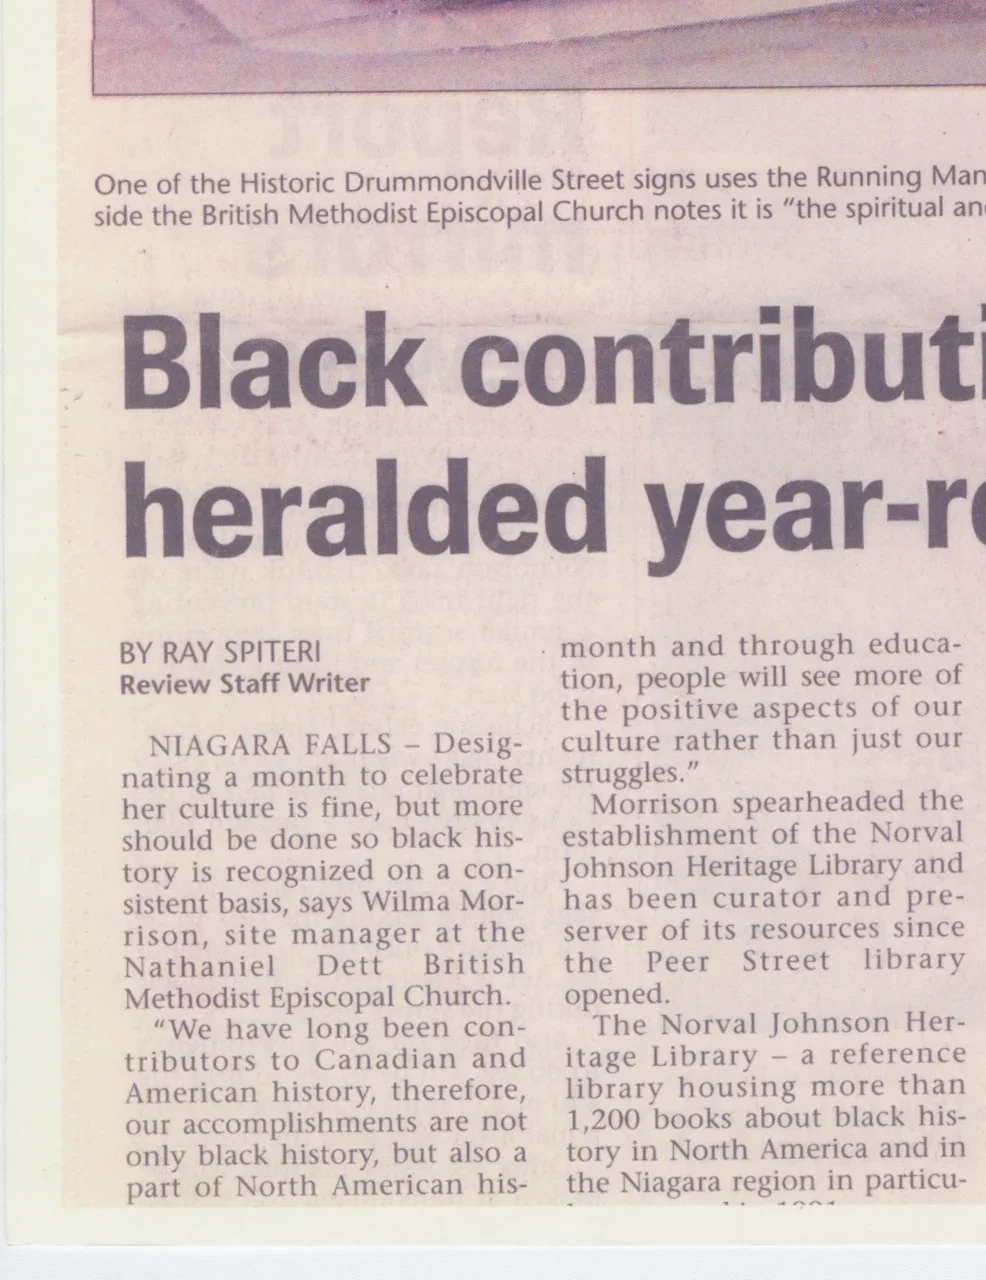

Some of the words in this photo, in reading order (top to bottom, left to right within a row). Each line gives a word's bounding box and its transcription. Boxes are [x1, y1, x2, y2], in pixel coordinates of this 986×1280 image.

[95, 174, 147, 195] One
[157, 172, 181, 195] of
[190, 172, 230, 194] the
[241, 172, 335, 194] Historic
[345, 169, 542, 192] Drummondville
[552, 168, 625, 190] Street
[634, 168, 696, 196] signs
[706, 172, 757, 189] uses
[767, 166, 807, 188] the
[818, 165, 922, 193] Running
[932, 164, 986, 186] Man
[95, 205, 143, 226] side
[152, 204, 192, 226] the
[203, 203, 278, 225] British
[289, 202, 418, 225] Methodist
[427, 200, 543, 230] Episcopal
[553, 199, 644, 222] Church
[655, 201, 722, 220] notes
[732, 198, 747, 219] it
[756, 198, 773, 219] is
[846, 195, 943, 225] spiritual
[124, 311, 427, 409] Black
[125, 456, 607, 558] heralded
[120, 641, 153, 664] BY
[163, 641, 214, 664] RAY
[224, 640, 320, 664] SPITERI
[120, 674, 211, 695] Review
[220, 672, 281, 694] Staff
[287, 672, 371, 693] Writer
[561, 668, 622, 693] tion,
[637, 666, 726, 696] people
[738, 665, 787, 687] will
[801, 670, 840, 687] see
[854, 669, 922, 686] more
[936, 662, 963, 685] of
[122, 767, 211, 795] nating
[225, 771, 238, 788] a
[253, 764, 346, 787] month
[360, 767, 387, 786] to
[401, 763, 523, 786] celebrate
[591, 793, 718, 815] Morrison
[733, 789, 904, 820] spearheaded
[919, 789, 963, 811] the
[560, 856, 674, 883] Johnson
[687, 855, 797, 883] Heritage
[809, 853, 903, 881] Library
[914, 852, 964, 874] and
[123, 894, 208, 915] sistent
[218, 892, 288, 917] basis,
[300, 896, 352, 920] says
[362, 890, 450, 912] Wilma
[460, 889, 524, 911] Mor-
[564, 951, 612, 974] the
[647, 951, 709, 972] Peer
[743, 949, 829, 972] Street
[864, 948, 965, 976] library
[124, 986, 260, 1009] Methodist
[270, 985, 394, 1015] Episcopal
[404, 984, 510, 1007] Church.
[125, 1082, 257, 1104] American
[272, 1080, 375, 1108] history,
[391, 1078, 525, 1104] therefore,
[126, 1119, 170, 1135] our
[183, 1112, 417, 1140] accomplishments
[430, 1116, 469, 1132] are
[482, 1112, 527, 1131] not
[569, 1109, 640, 1134] 1,200
[654, 1107, 732, 1129] books
[745, 1107, 821, 1129] about
[834, 1105, 905, 1127] black
[918, 1104, 966, 1126] his-
